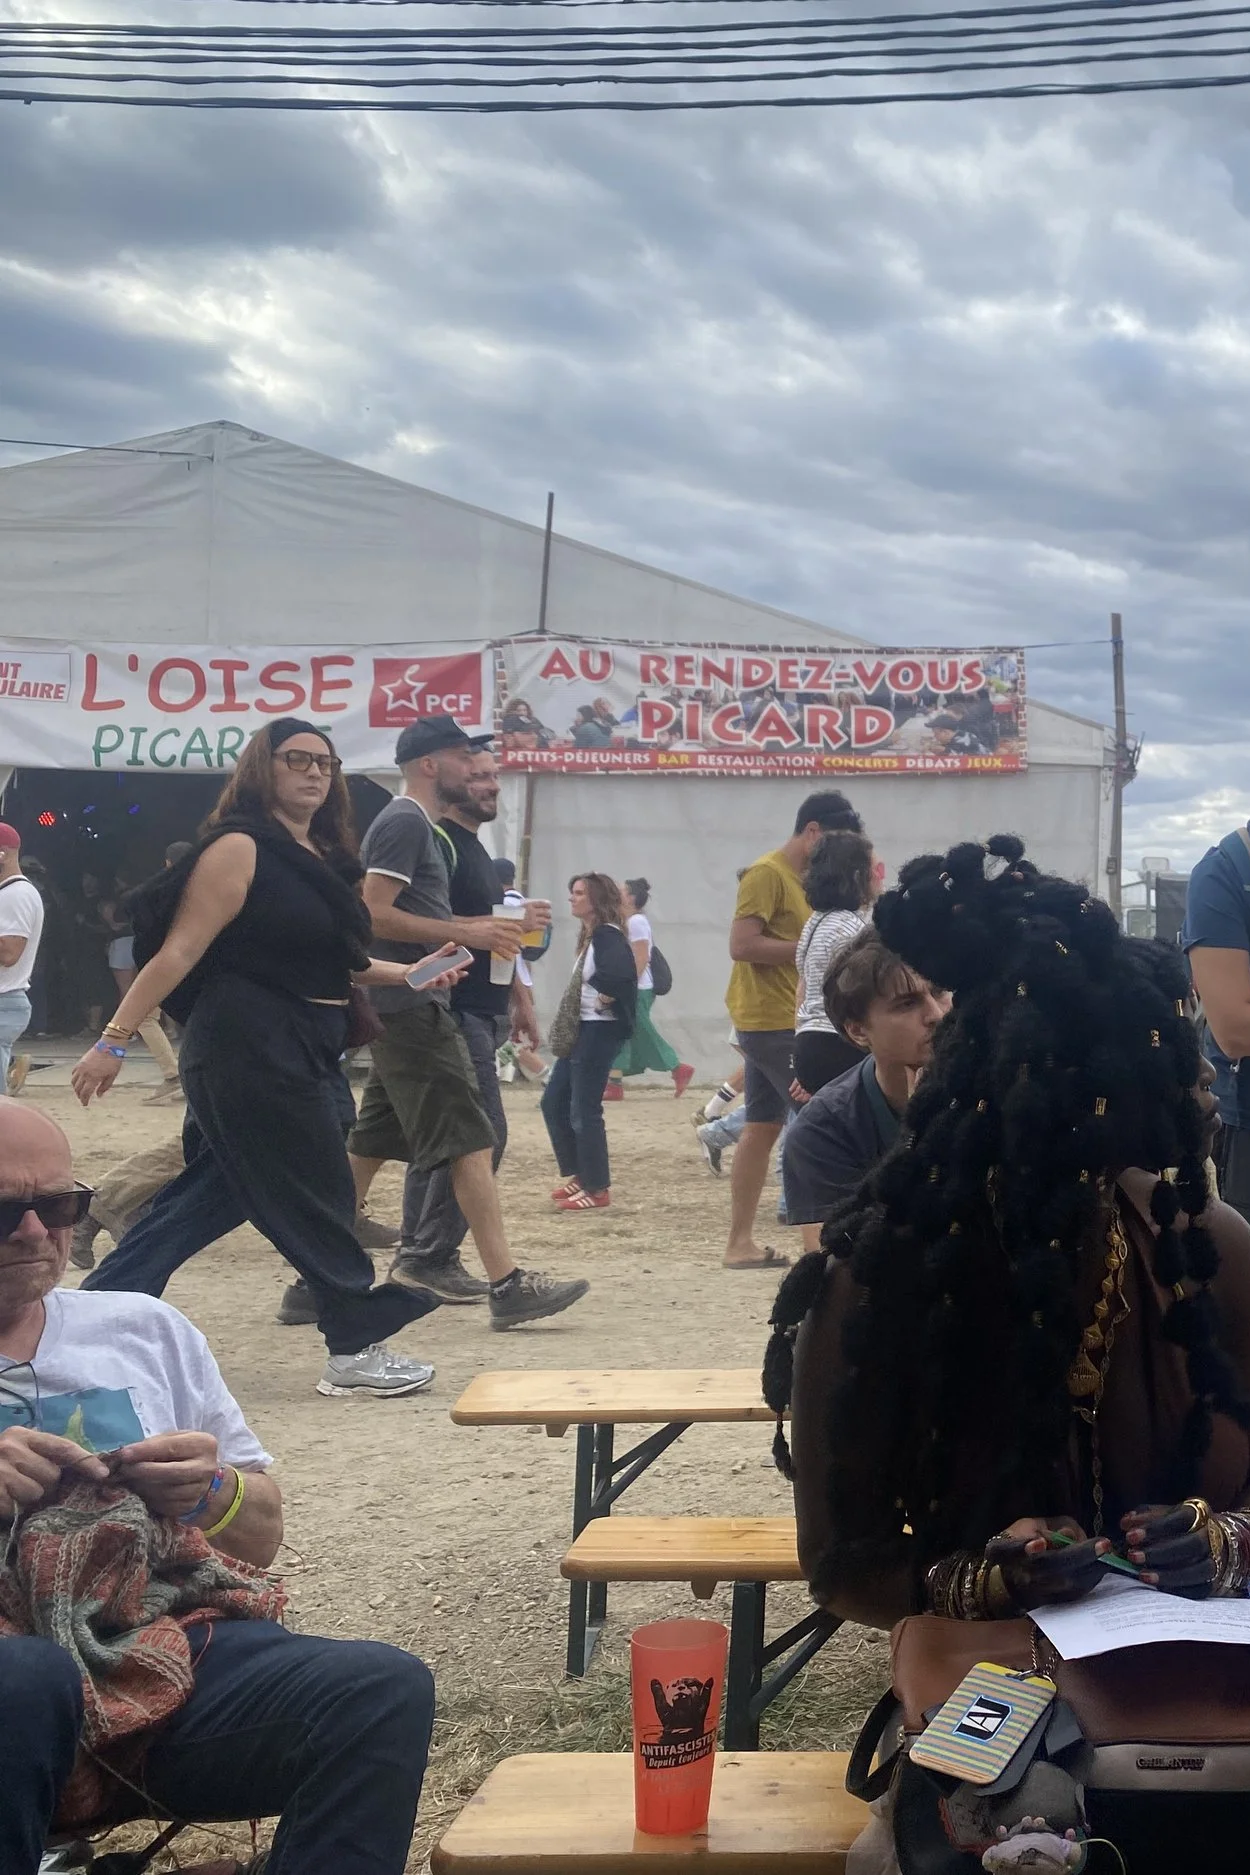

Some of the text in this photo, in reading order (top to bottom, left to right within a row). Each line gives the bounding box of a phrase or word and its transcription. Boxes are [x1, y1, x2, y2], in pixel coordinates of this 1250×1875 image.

[81, 653, 355, 714] L'OISE
[538, 647, 986, 695] AU RENDEZ-VOUS
[425, 693, 473, 713] PCF
[636, 700, 896, 749] PICARD
[92, 724, 332, 767] PICAR
[506, 750, 651, 765] PETITS-DÉJEUNERS
[657, 752, 690, 765] BAR
[697, 754, 815, 767] RESTAURATION
[822, 755, 899, 769] CONCERTS
[906, 755, 961, 769] DÉBATS
